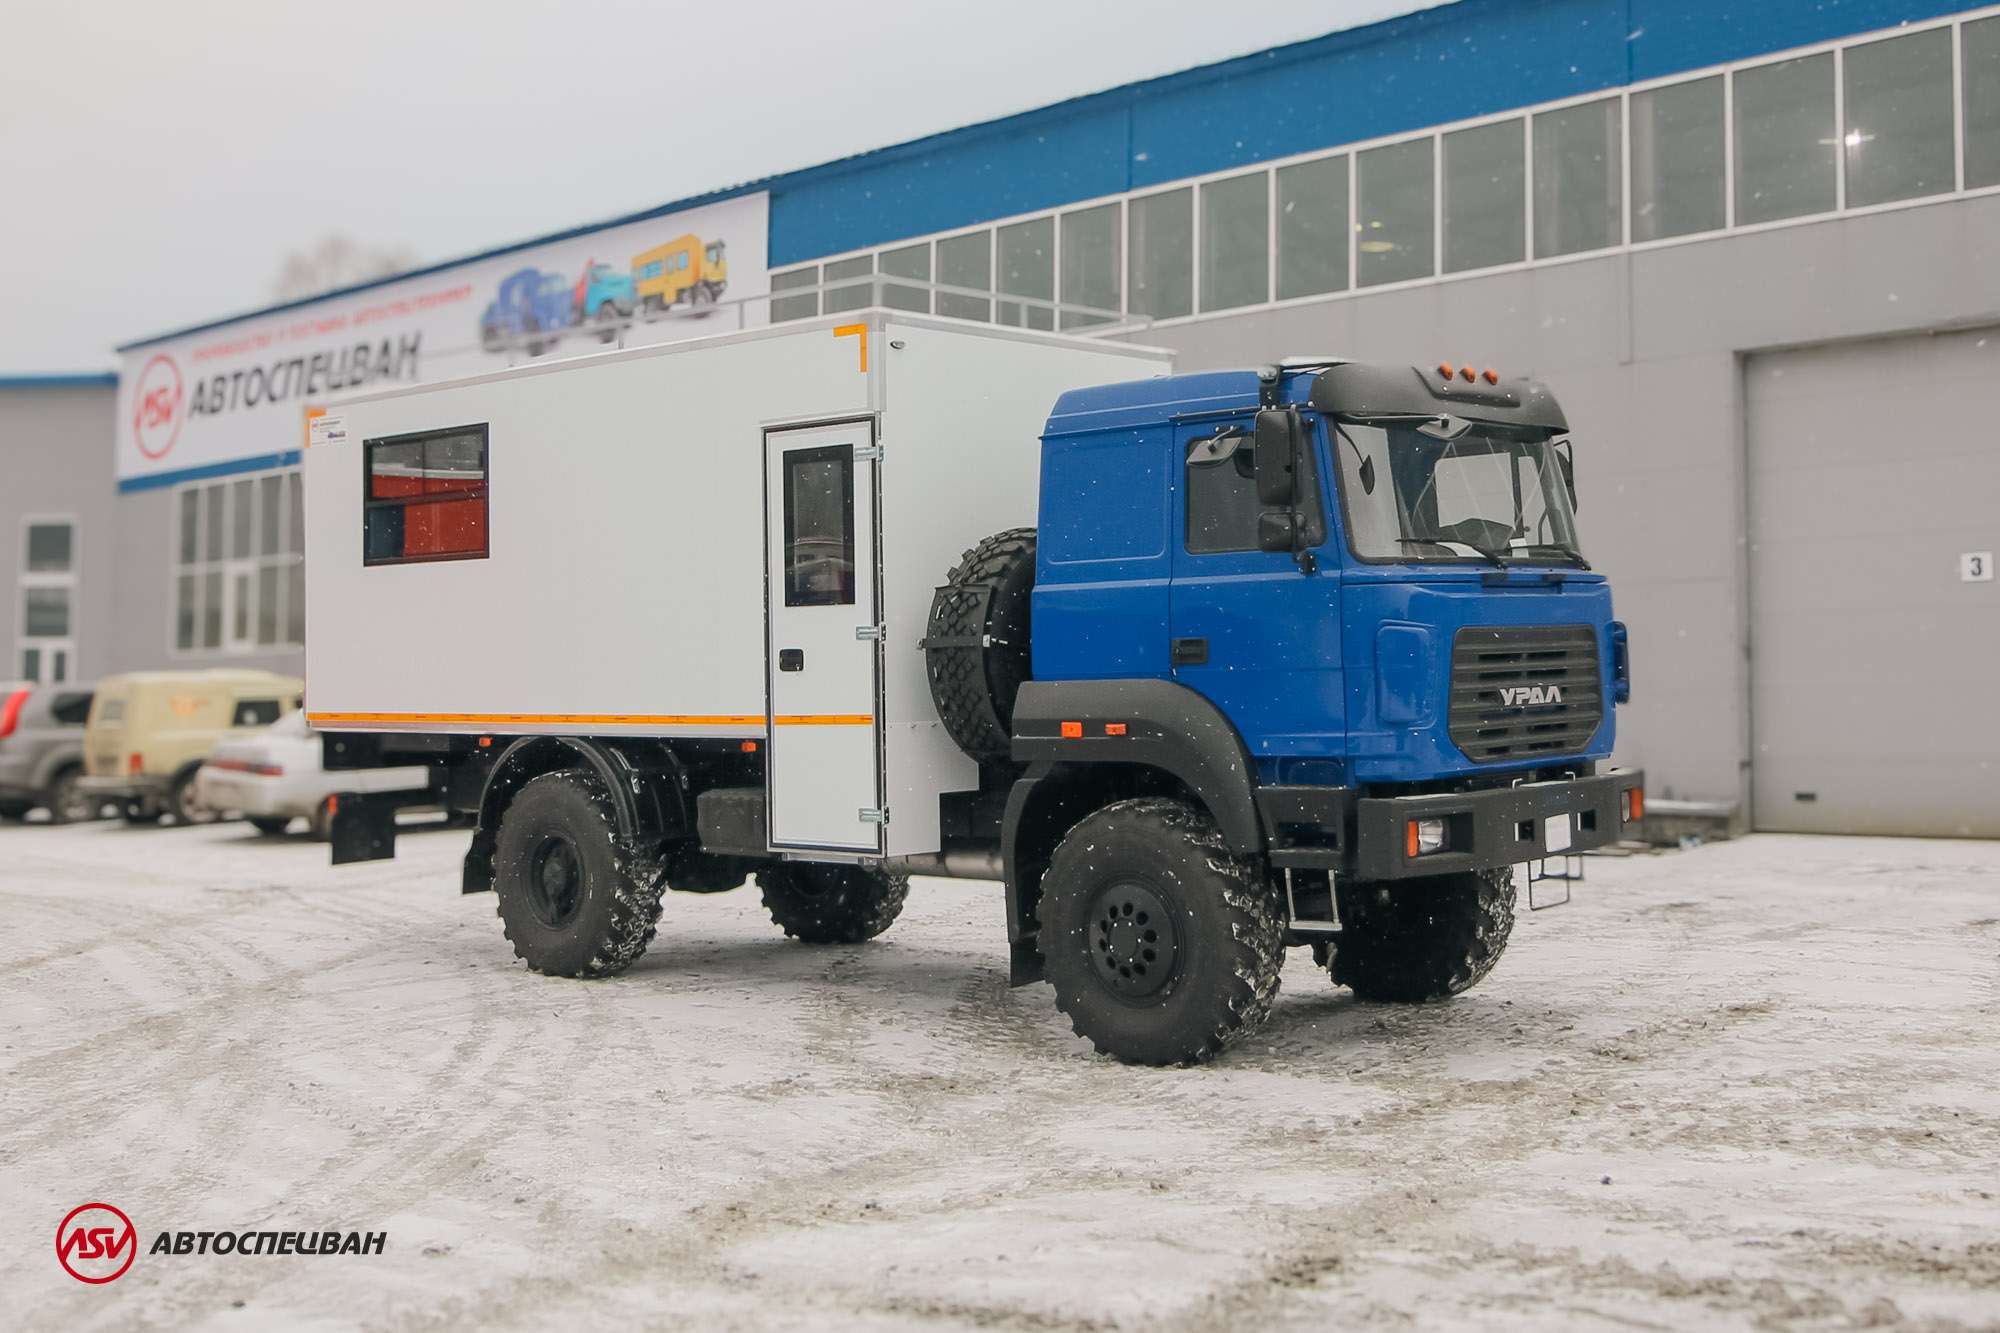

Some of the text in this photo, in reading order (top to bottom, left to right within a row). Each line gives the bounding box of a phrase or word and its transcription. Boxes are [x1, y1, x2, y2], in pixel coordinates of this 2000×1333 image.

[188, 329, 422, 418] АВТОСПЕЦВАН
[1970, 556, 1983, 577] 3
[1500, 685, 1562, 706] УРАЛ
